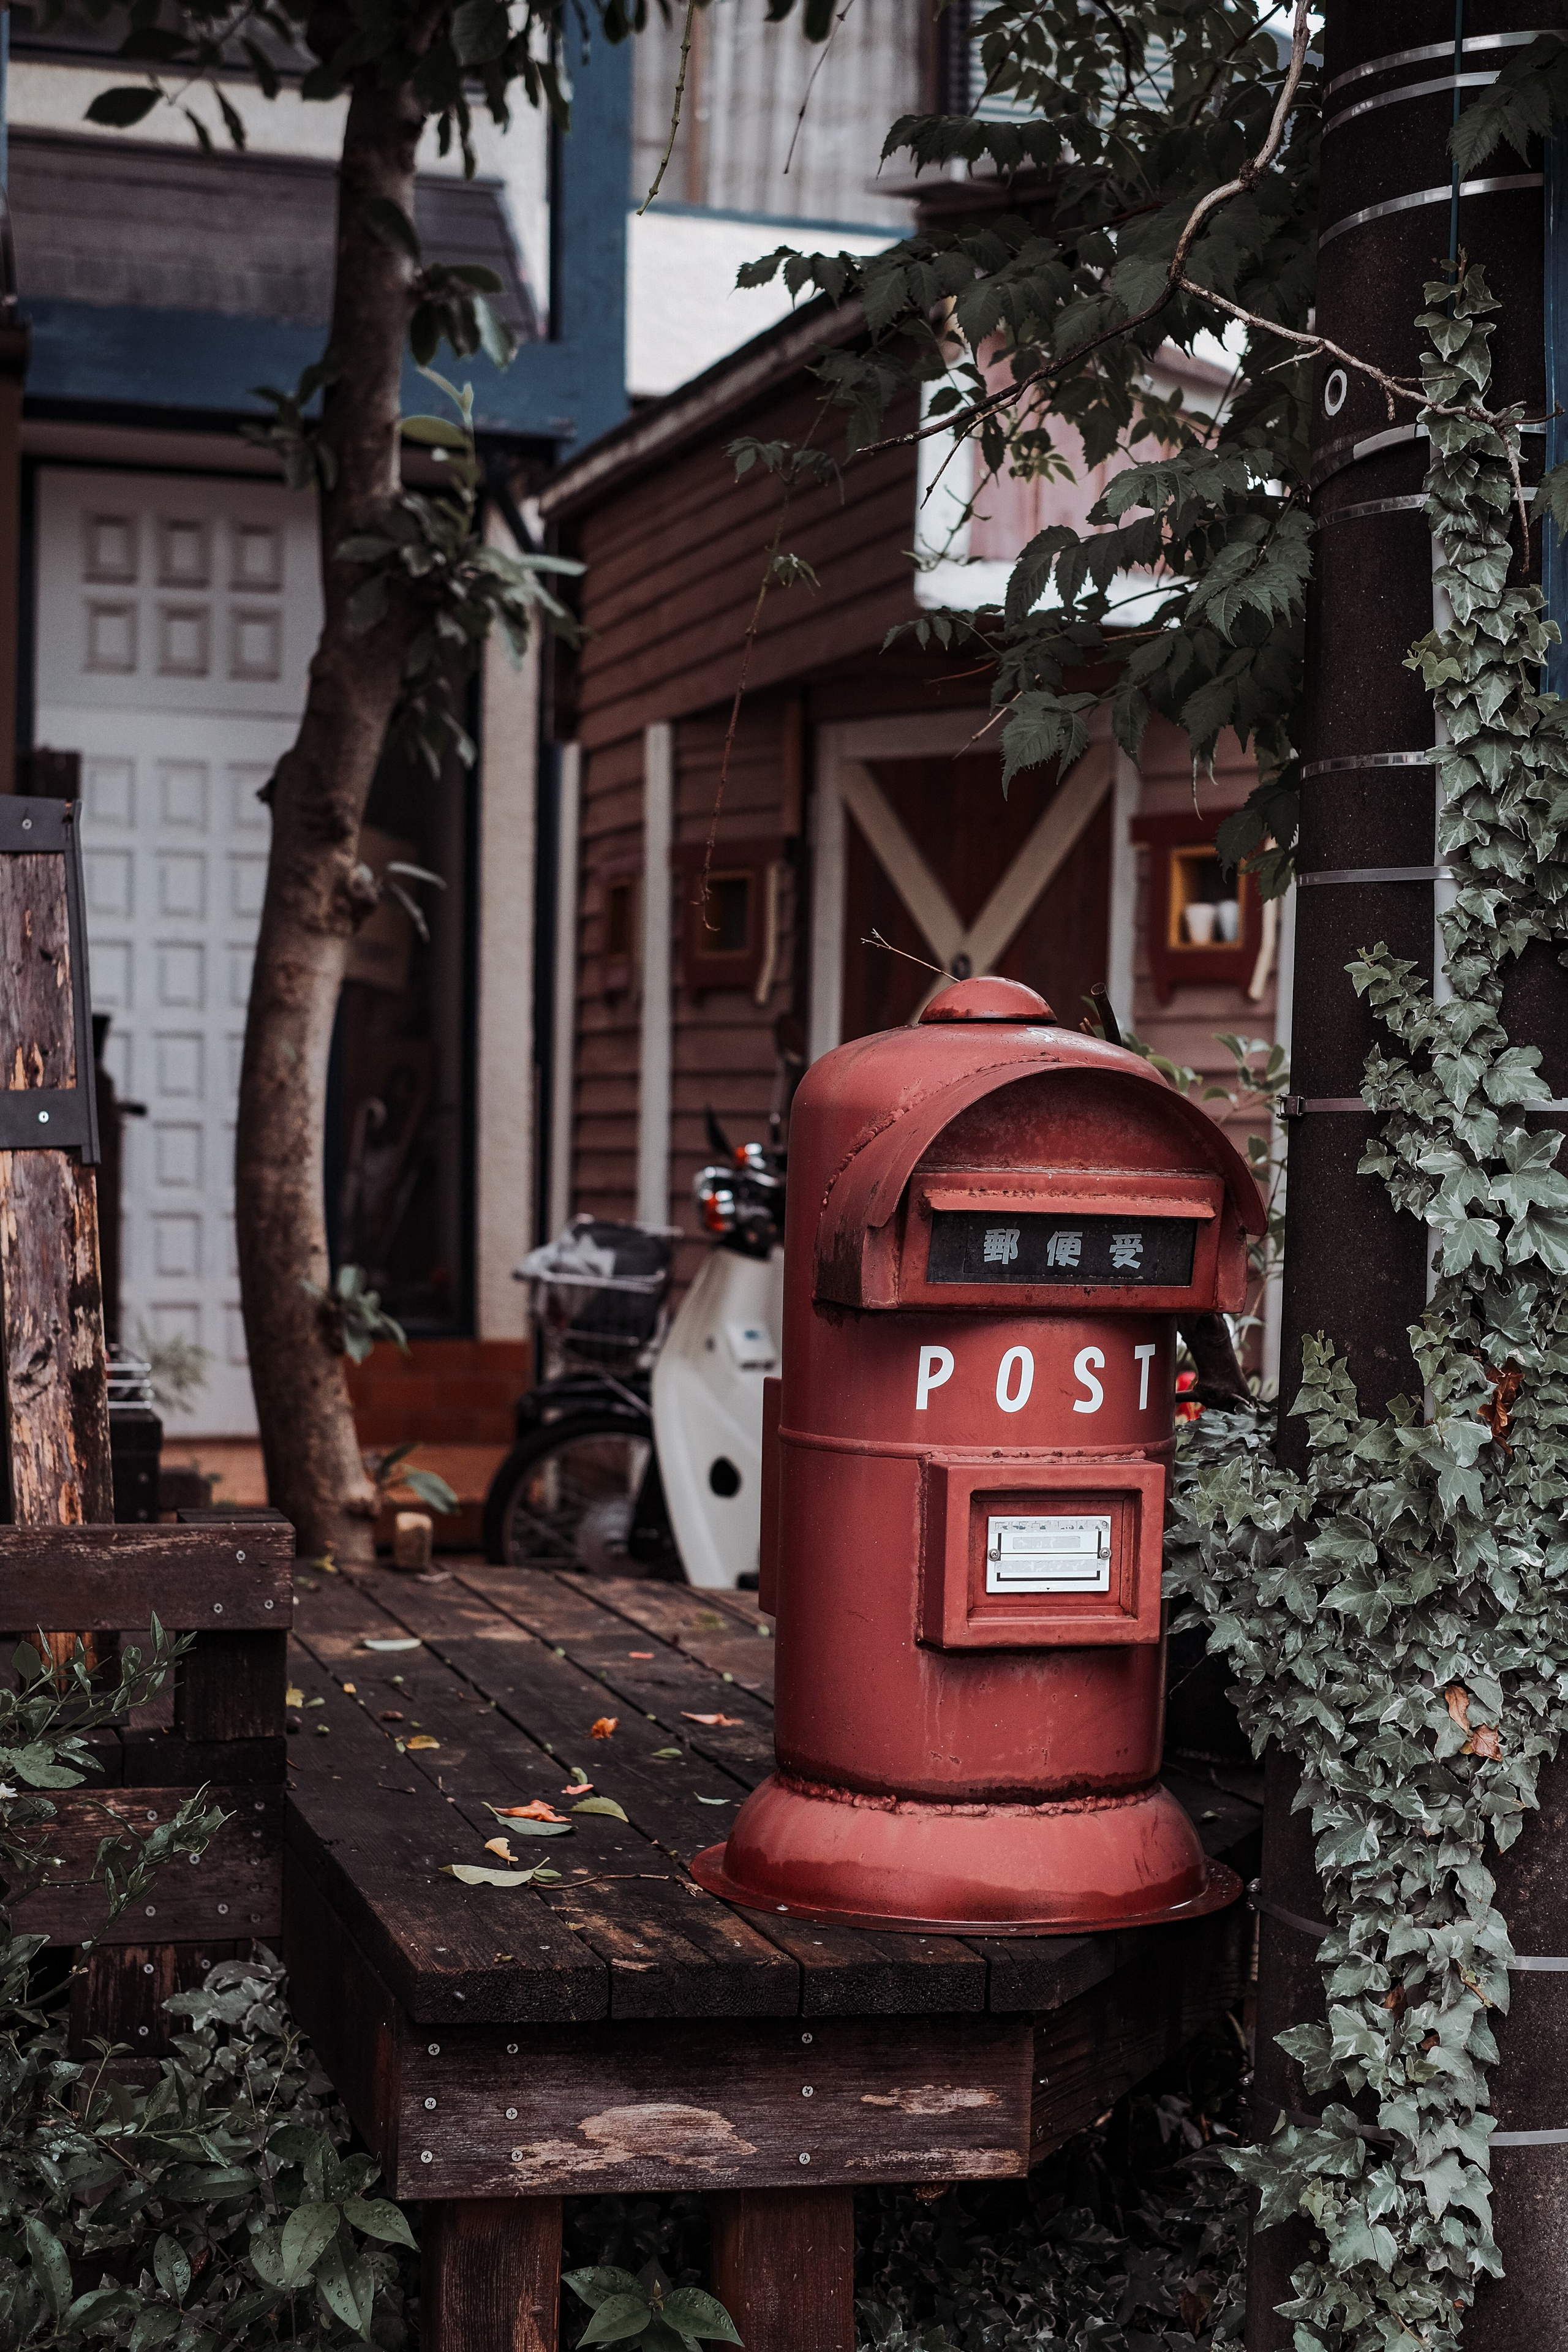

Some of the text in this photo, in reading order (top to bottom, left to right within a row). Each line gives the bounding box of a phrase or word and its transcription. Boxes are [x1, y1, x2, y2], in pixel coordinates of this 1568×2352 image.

[984, 1228, 1144, 1269] 郵便受
[915, 1344, 1156, 1414] POST
